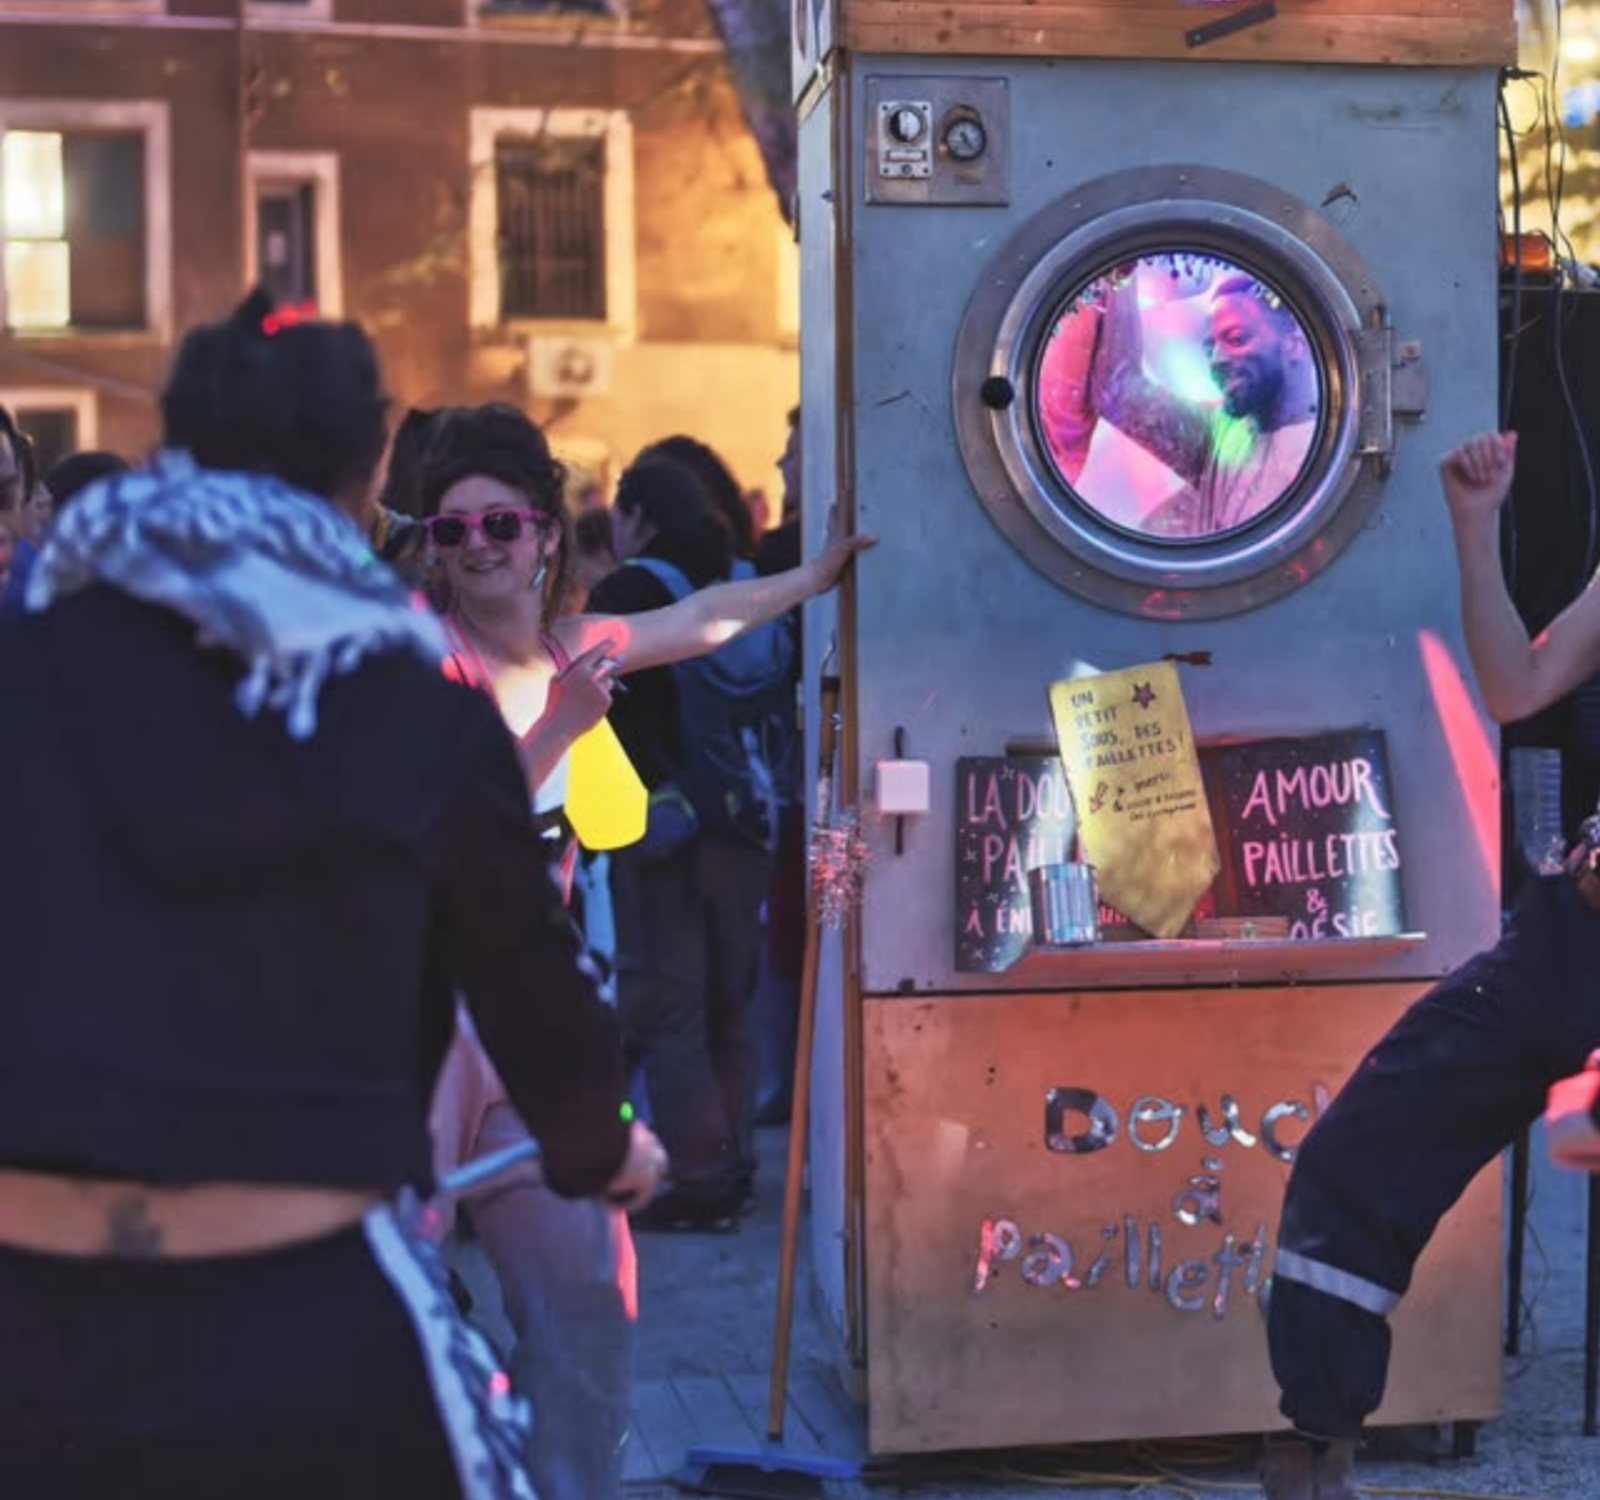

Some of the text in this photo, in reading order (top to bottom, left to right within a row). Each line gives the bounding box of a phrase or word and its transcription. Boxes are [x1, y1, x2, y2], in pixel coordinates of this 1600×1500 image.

[1071, 691, 1094, 707] UN
[967, 771, 1008, 831] LA
[1016, 770, 1073, 823] DOU
[1241, 757, 1391, 826] AMOUR
[996, 900, 1034, 934] ÉN
[1306, 888, 1328, 913] &
[1045, 1083, 1328, 1162] Douc
[975, 1213, 1274, 1320] Paillett
